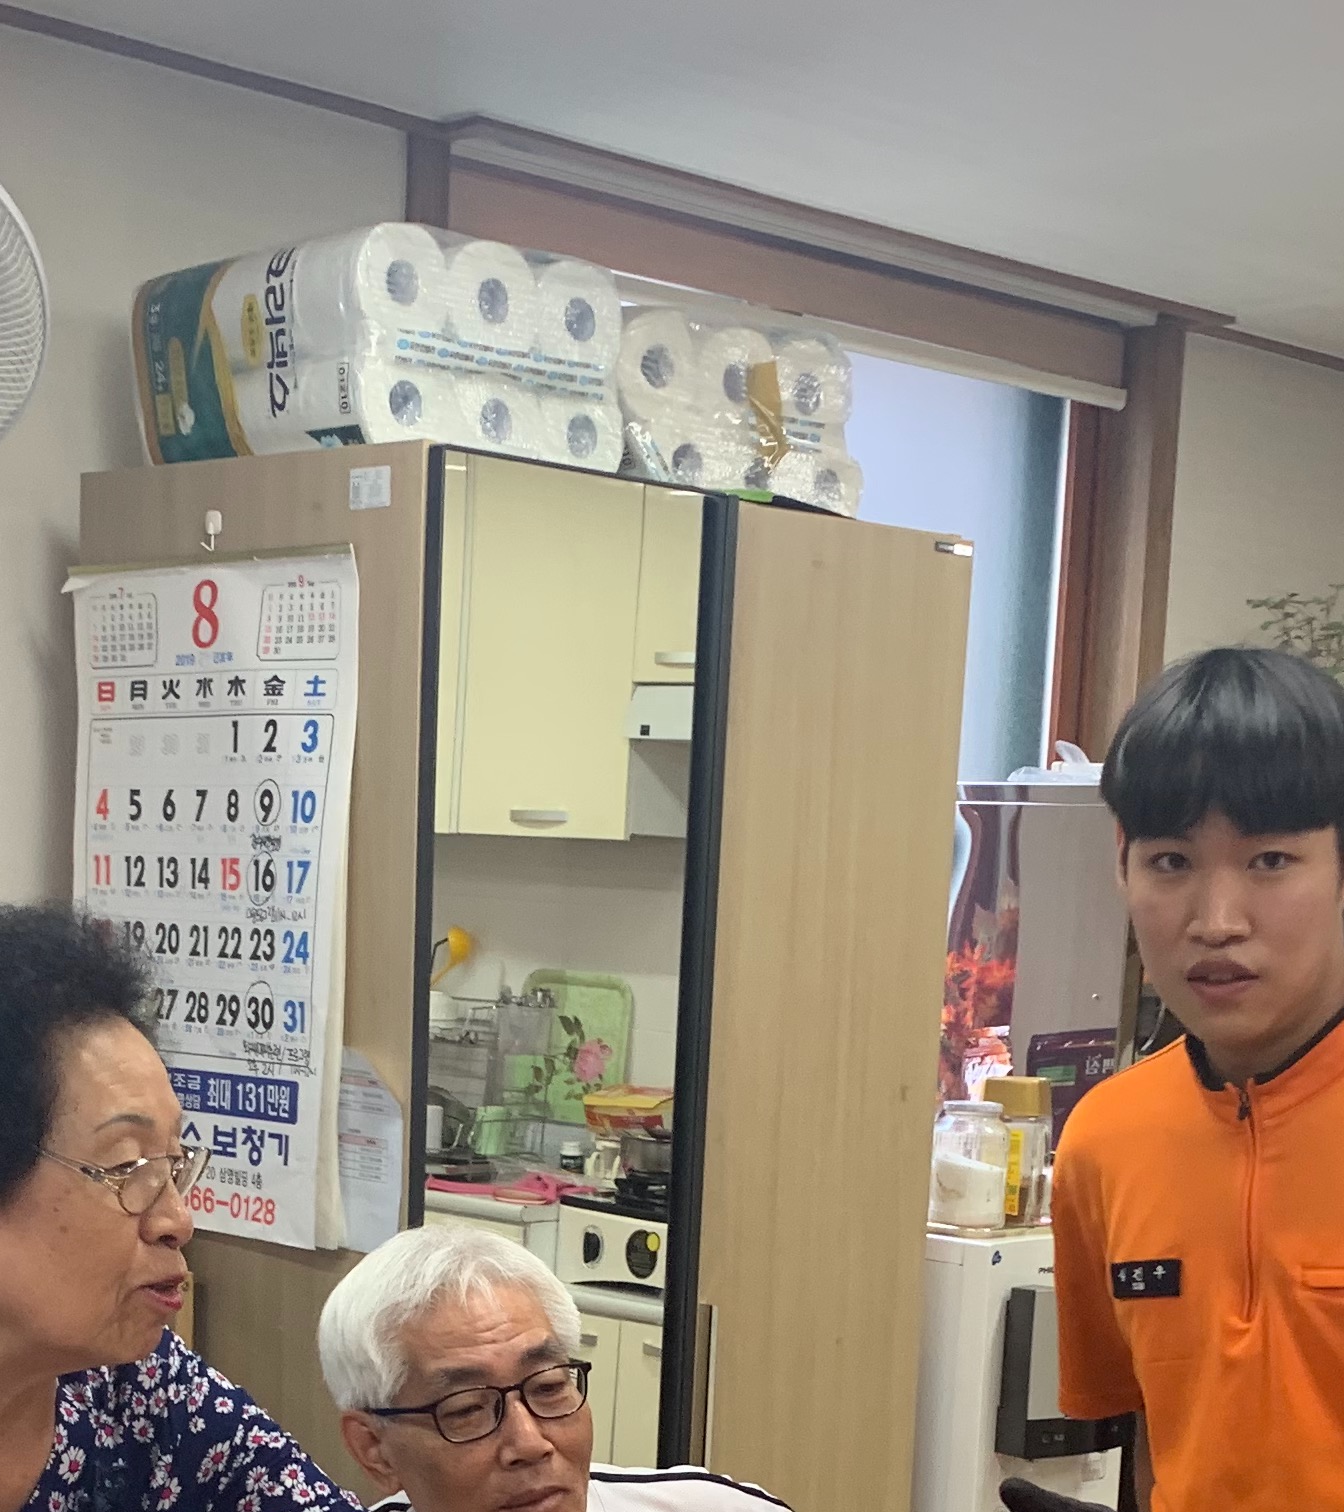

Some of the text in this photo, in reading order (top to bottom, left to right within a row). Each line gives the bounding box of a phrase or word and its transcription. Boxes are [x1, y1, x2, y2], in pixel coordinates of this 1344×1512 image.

[298, 574, 305, 588] 9
[192, 579, 220, 649] 8
[97, 674, 327, 702] 日 月 火 水 木 金 土
[232, 719, 319, 753] 1 2 3
[96, 788, 317, 824] 4 5 6 7 8 9 10
[93, 855, 312, 894] 11 12 13 14 15 16 17
[124, 920, 145, 950] 19
[155, 922, 180, 955] 20
[189, 924, 209, 957] 21
[217, 926, 242, 960] 22
[249, 927, 275, 962] 23
[281, 930, 310, 965] 24
[155, 987, 179, 1021] 27
[184, 991, 209, 1024] 28
[215, 993, 241, 1027] 29
[247, 996, 274, 1030] 30
[283, 1000, 305, 1034] 31
[168, 1072, 201, 1091] 조금
[207, 1077, 291, 1119] 최대 131만원
[212, 1124, 290, 1167] 보청기
